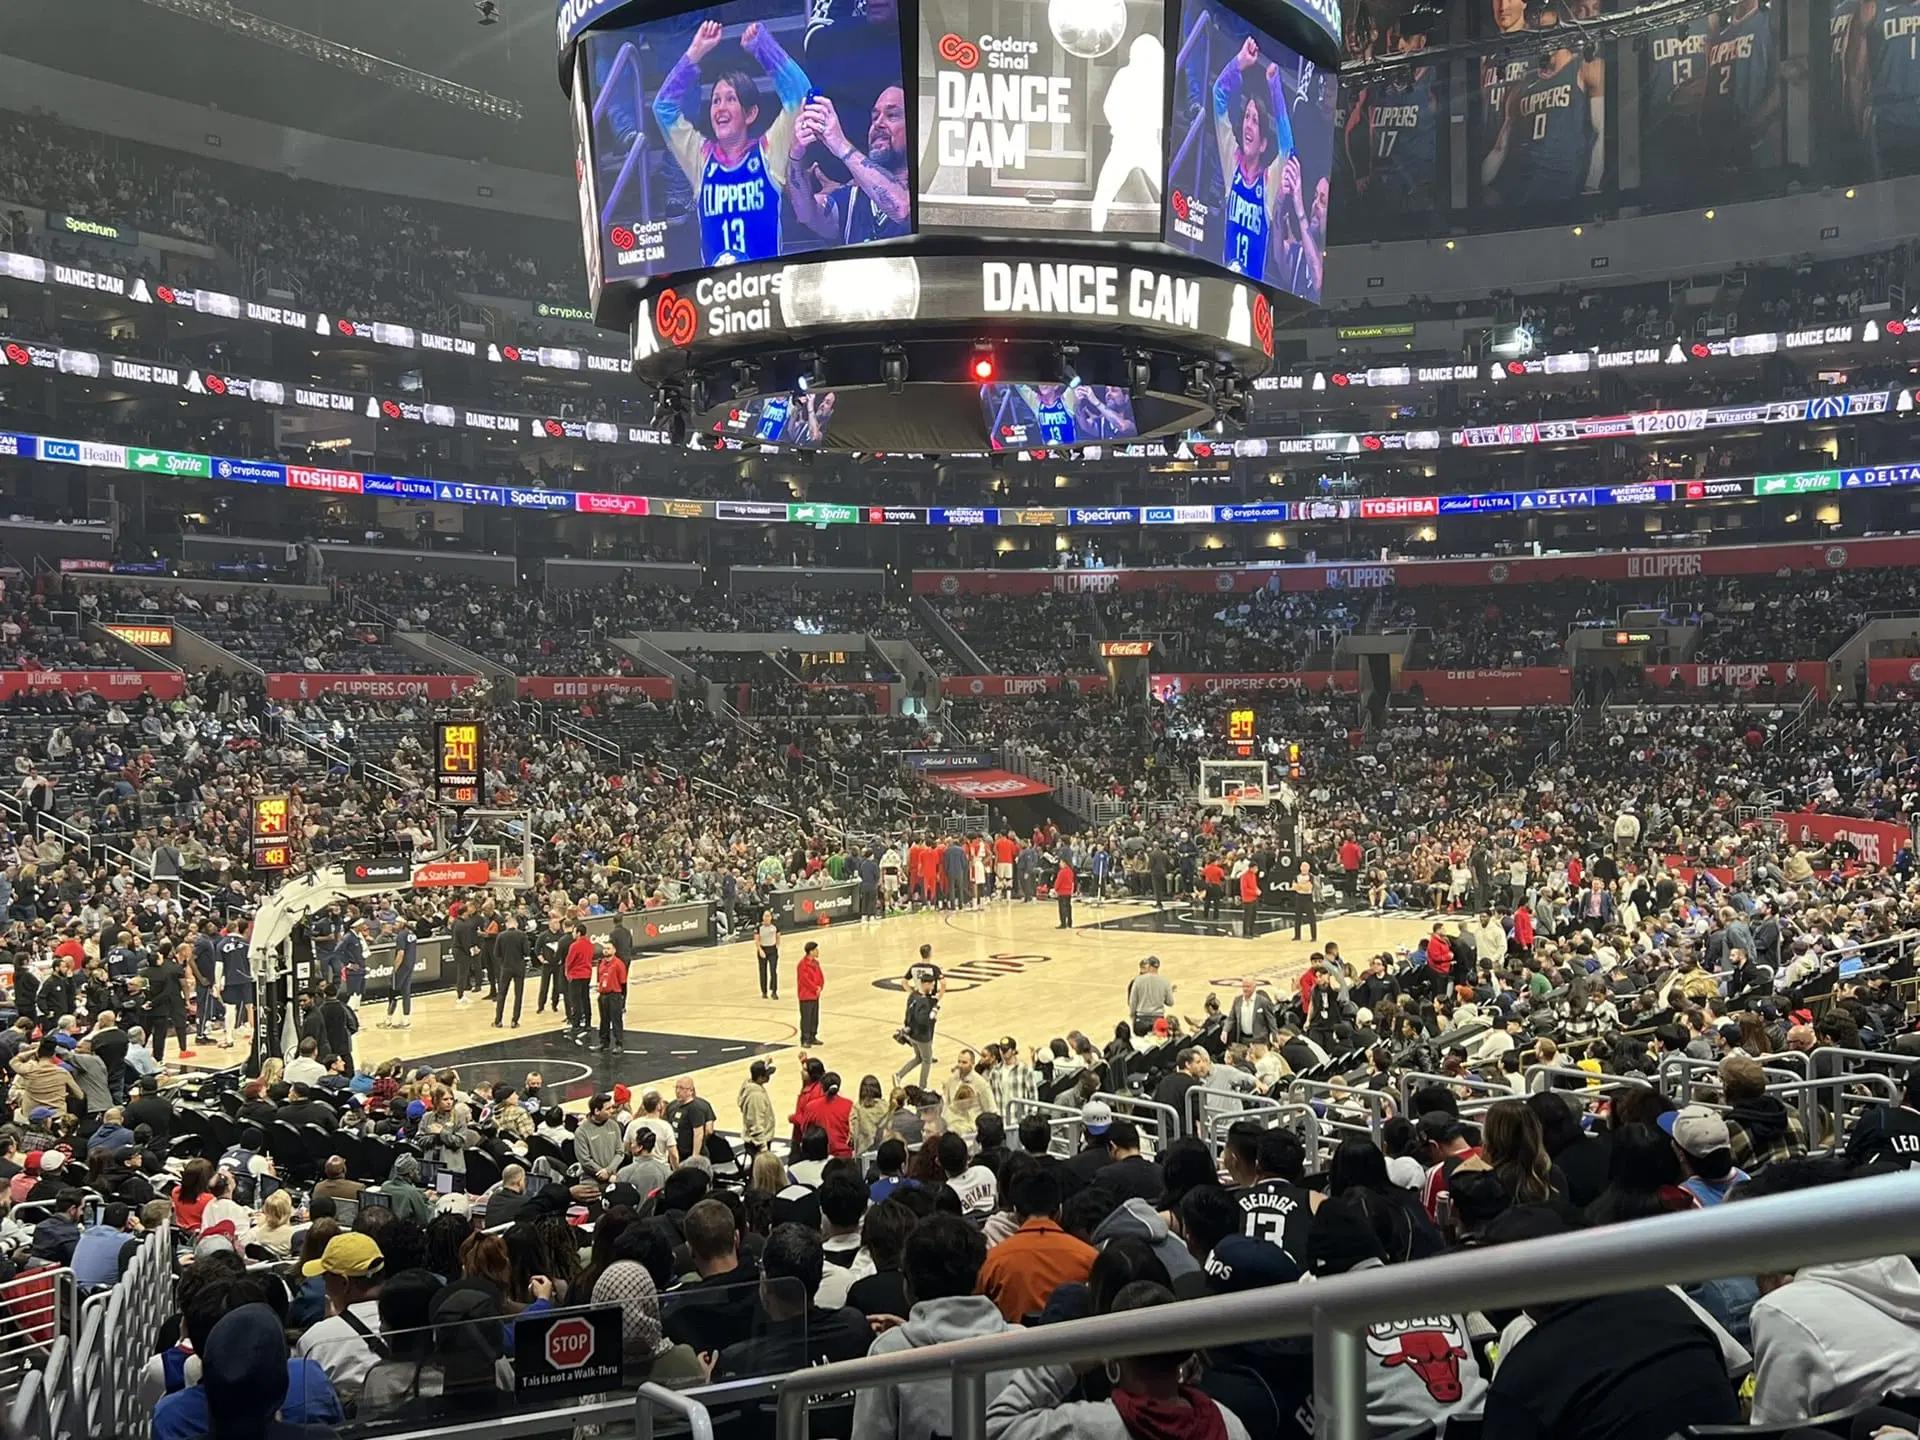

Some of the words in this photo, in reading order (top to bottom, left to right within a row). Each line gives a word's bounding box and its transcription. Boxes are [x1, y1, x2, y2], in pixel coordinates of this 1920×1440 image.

[979, 35, 1038, 54] Cedars
[988, 52, 1029, 70] Sinai
[1720, 65, 1731, 94] 2
[938, 70, 1072, 123] DANCE
[1521, 84, 1571, 116] CLIPPERS
[1369, 104, 1419, 127] CLIPPERS
[1532, 113, 1547, 140] 0
[938, 120, 1026, 170] CAM
[1379, 130, 1397, 157] 17
[704, 178, 764, 217] CLIPPERS
[1230, 189, 1262, 236] CLIPPERS
[65, 216, 118, 238] Spectrum
[633, 221, 668, 236] Cedars
[722, 218, 746, 253] 13
[638, 233, 664, 246] Sinai
[618, 249, 646, 266] DANCE
[647, 246, 665, 260] CAM
[1236, 232, 1249, 268] 13
[55, 265, 96, 290] DANCE
[96, 273, 124, 295] CAM
[696, 272, 784, 306] Cedars
[982, 262, 1118, 316] DANCE
[1129, 267, 1200, 330] CAM
[248, 302, 282, 325] DANCE
[283, 309, 306, 330] CAM
[709, 300, 771, 336] Sinai
[421, 333, 454, 352] DANCE
[455, 338, 475, 356] CAM
[1786, 330, 1824, 348] DANCE
[1825, 326, 1852, 343] CAM
[28, 346, 59, 361] Cedars
[1598, 351, 1633, 368] DANCE
[1634, 348, 1660, 364] CAM
[112, 360, 151, 383] DANCE
[151, 367, 178, 386] CAM
[588, 356, 620, 372] DANCE
[1280, 375, 1302, 390] CAM
[1418, 367, 1453, 382] DANCE
[1454, 365, 1478, 379] CAM
[296, 389, 330, 410] DANCE
[331, 395, 354, 412] CAM
[466, 412, 496, 430] DANCE
[497, 416, 519, 432] CAM
[1546, 424, 1567, 439] 33
[1585, 423, 1627, 435] Clippers
[1640, 411, 1687, 433] 12:00
[1716, 411, 1758, 424] Wizards
[1779, 405, 1798, 418] 30
[629, 429, 660, 445] DANCE
[1280, 440, 1313, 453] DANCE
[1314, 438, 1336, 451] CAM
[48, 444, 77, 458] UCLA
[83, 446, 122, 464] Health
[165, 455, 202, 471] Sprite
[232, 464, 281, 479] crypto.com
[290, 470, 360, 490] TOSHIBA
[1865, 468, 1920, 482] DELTA
[402, 482, 432, 495] ULTRA
[1611, 486, 1656, 496] AMERICAN
[1704, 483, 1741, 494] TOYOTA
[1793, 475, 1831, 489] Sprite
[455, 486, 499, 502] DELTA
[511, 490, 566, 505] Spectrum
[1480, 497, 1511, 508] ULTRA
[1537, 492, 1588, 505] DELTA
[820, 509, 850, 519] Sprite
[884, 511, 916, 520] TOYOTA
[944, 510, 984, 518] AMERICAN
[1178, 510, 1209, 520] Health
[1234, 508, 1280, 517] crypto.com
[1366, 499, 1434, 514] TOSHIBA
[1077, 510, 1131, 523] Spectrum
[1643, 554, 1702, 577] CLIPPERS
[334, 681, 429, 696] CLIPPERS.COM
[1205, 677, 1301, 694] CLIPPERS.COM
[1231, 721, 1252, 738] 24
[445, 743, 473, 771] 24
[952, 757, 977, 765] ULTRA
[260, 815, 280, 833] 24
[367, 867, 388, 876] Cedars
[389, 866, 403, 875] Sinai
[428, 870, 448, 880] State
[448, 869, 466, 879] Farm
[814, 899, 836, 911] Cedars
[836, 896, 852, 907] Sinai
[658, 923, 682, 935] Cedars
[682, 919, 698, 931] Sinai
[590, 933, 610, 946] Ceda
[961, 1184, 991, 1210] BRYANT
[1239, 1193, 1298, 1214] GEORGE
[1245, 1212, 1286, 1249] 13
[552, 1334, 588, 1354] STOP
[540, 1373, 549, 1385] is
[550, 1372, 562, 1384] not
[567, 1372, 573, 1381] a
[574, 1365, 618, 1380] Walk-Thru
